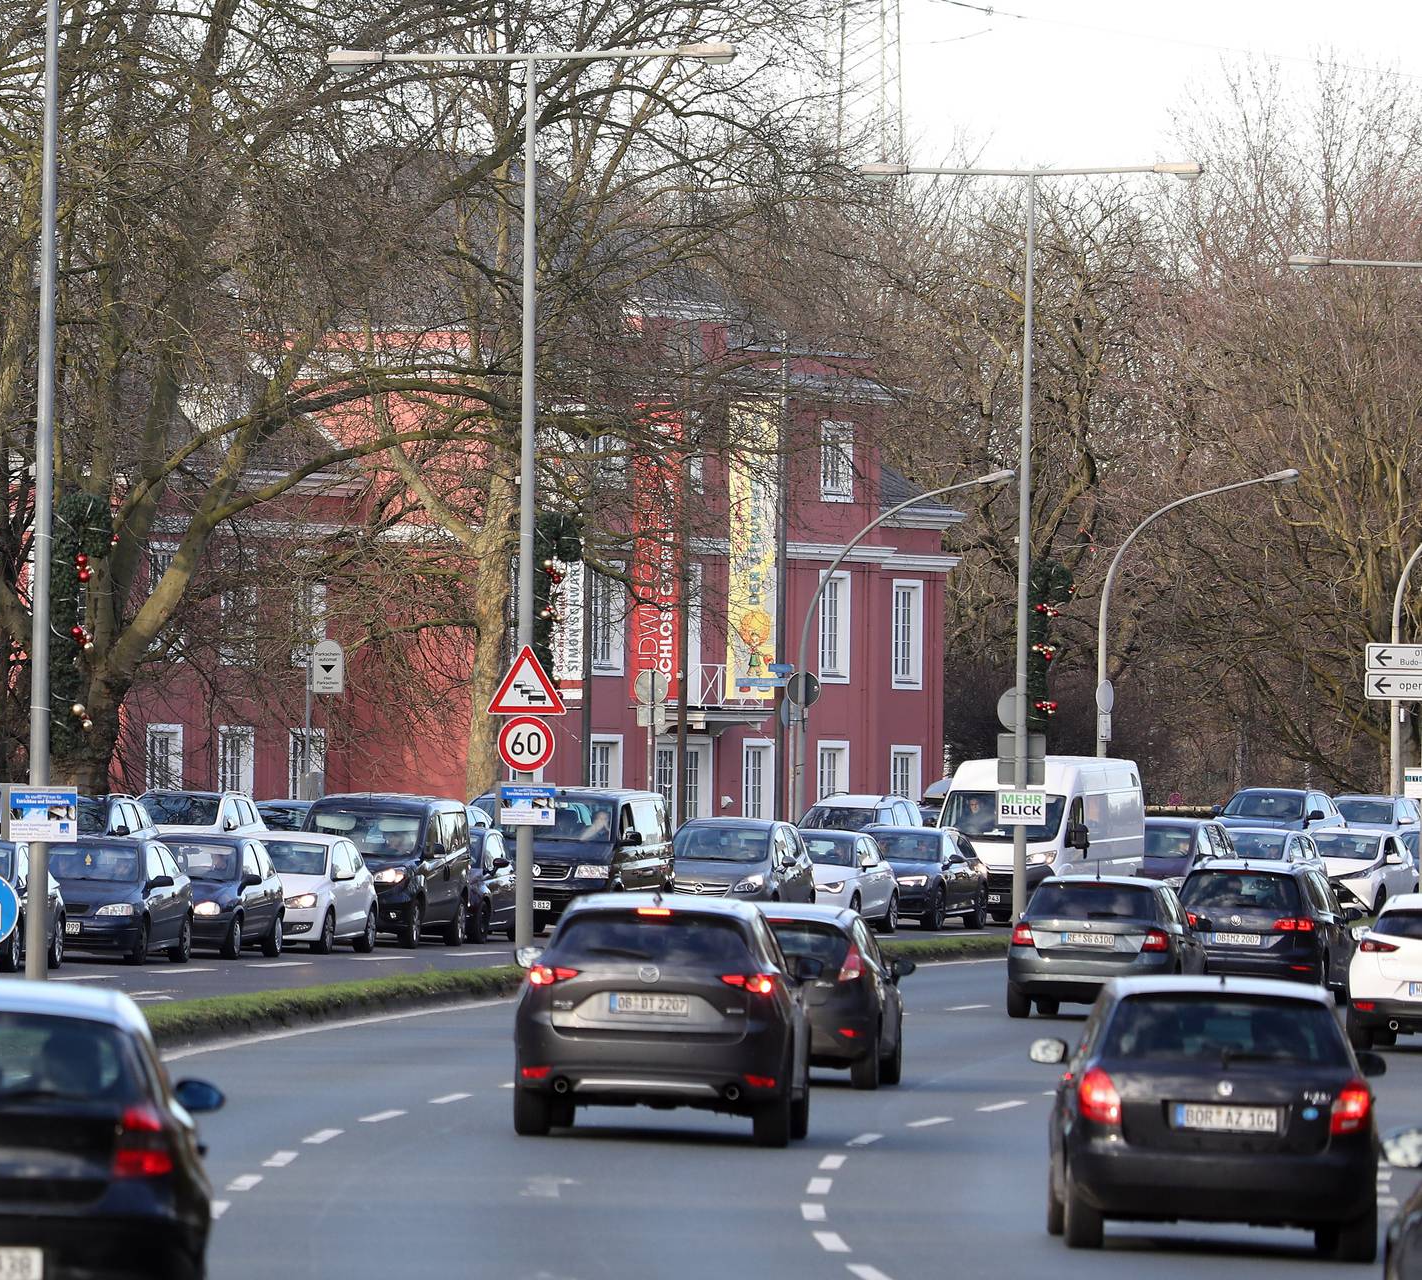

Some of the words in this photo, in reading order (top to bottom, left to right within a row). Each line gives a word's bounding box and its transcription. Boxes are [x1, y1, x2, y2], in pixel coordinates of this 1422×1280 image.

[567, 628, 579, 672] SIMON
[511, 732, 541, 756] 60
[1001, 794, 1043, 805] MEHR
[1001, 805, 1043, 816] BLICK
[538, 901, 550, 909] 812
[1094, 935, 1114, 945] 6100
[618, 996, 633, 1009] OB
[658, 998, 687, 1011] 2207
[1186, 1109, 1213, 1123] BOR
[1225, 1111, 1243, 1126] AZ
[1249, 1112, 1275, 1129] 104
